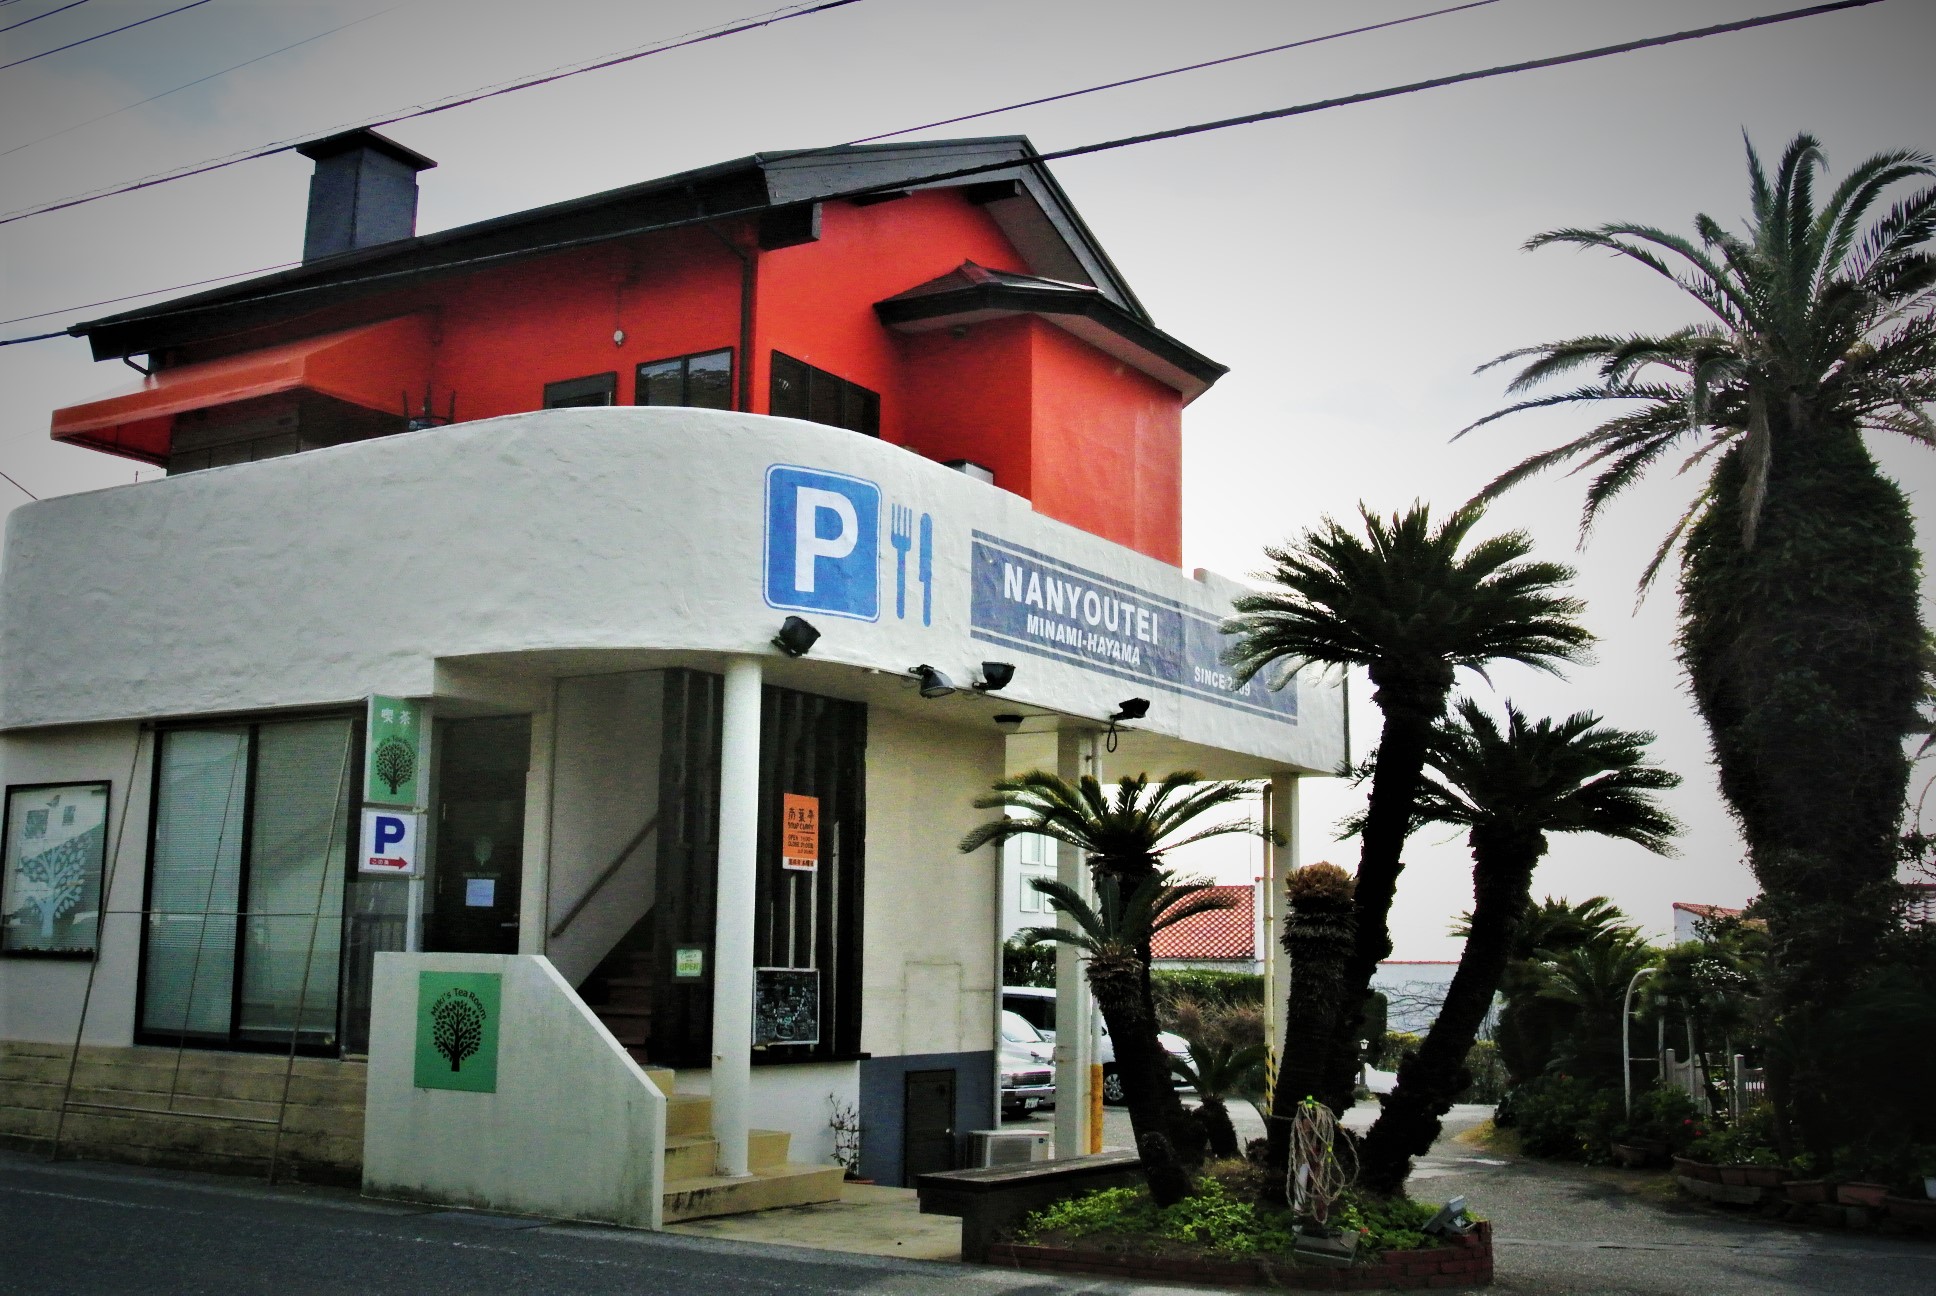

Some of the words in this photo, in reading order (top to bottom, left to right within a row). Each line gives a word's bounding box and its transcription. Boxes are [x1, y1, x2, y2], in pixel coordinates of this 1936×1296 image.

[795, 486, 858, 592] P
[1004, 563, 1158, 645] NANYOUTEI
[1027, 614, 1141, 666] MINAMI-HAYAMA
[1194, 665, 1226, 689] SINCE
[381, 707, 411, 724] 喫茶
[374, 816, 405, 854] P
[453, 987, 468, 997] Tea
[468, 991, 487, 1020] Room
